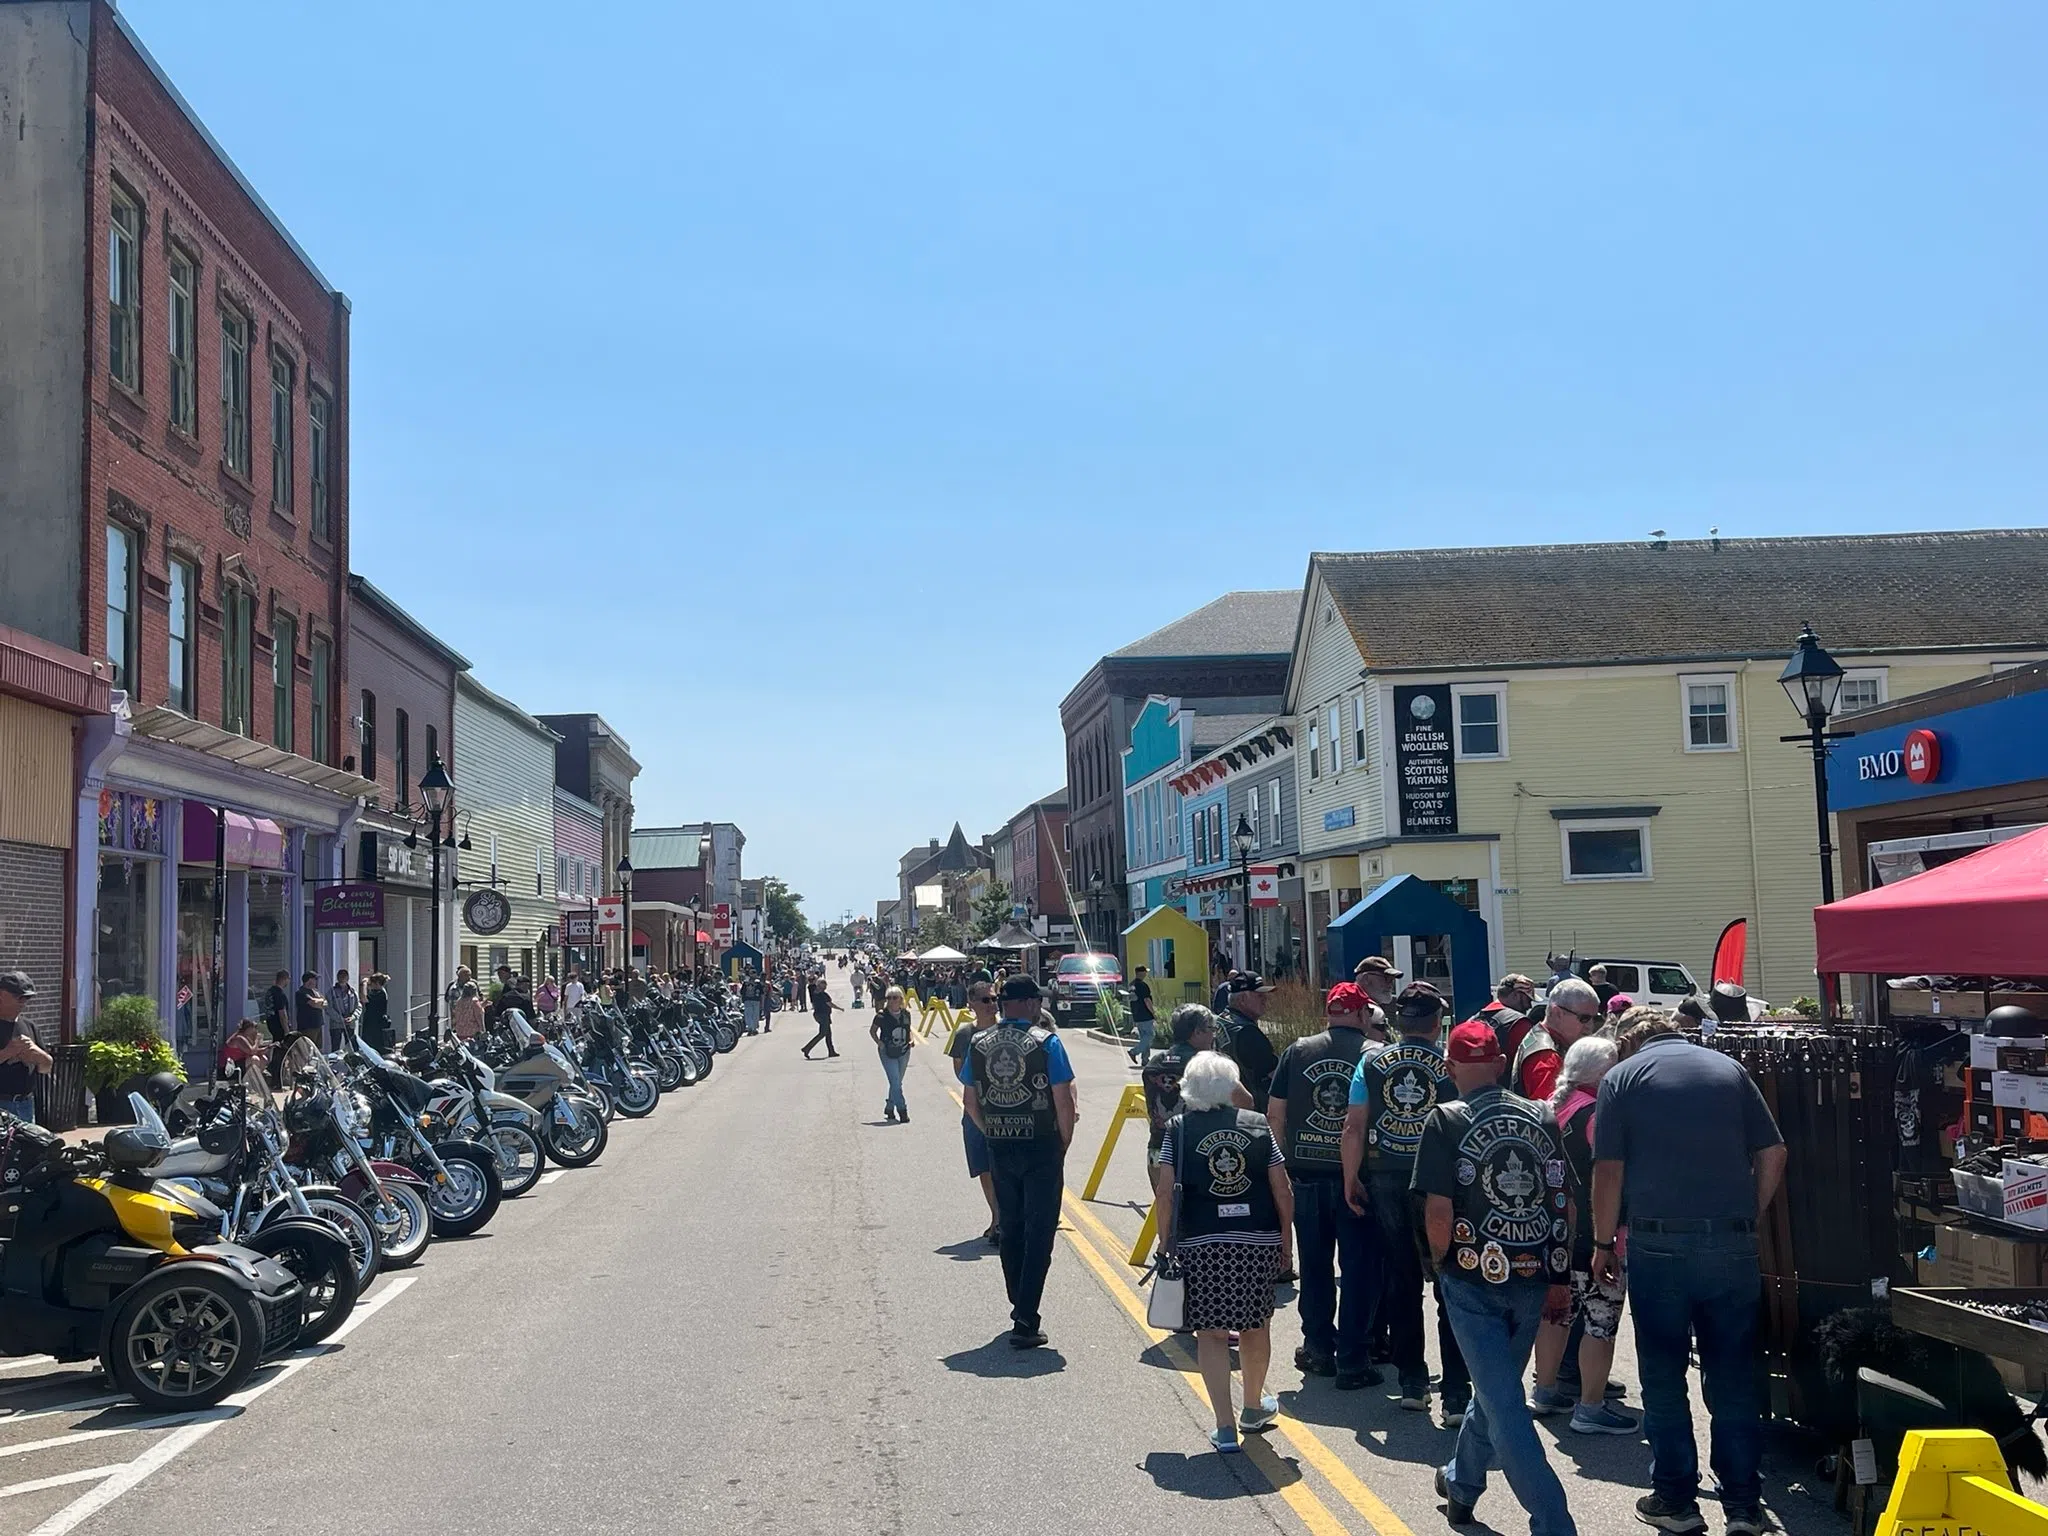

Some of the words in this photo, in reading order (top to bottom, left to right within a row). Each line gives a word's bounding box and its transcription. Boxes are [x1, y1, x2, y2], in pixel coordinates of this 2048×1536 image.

[1405, 732, 1445, 742] ENGLISH
[1401, 742, 1449, 752] WOOLLENS
[1858, 750, 1899, 780] BMO
[1404, 766, 1448, 776] SCOTTISH
[1406, 775, 1448, 785] TARTANS
[1405, 792, 1434, 800] HUDSON
[1436, 791, 1450, 799] BAY
[1412, 800, 1443, 809] COATS
[1406, 816, 1452, 826] BLANKETS
[352, 908, 376, 918] thing
[979, 1029, 1034, 1050] VETERANS
[1375, 1048, 1447, 1078] VETERANS
[1308, 1062, 1354, 1079] VETERA
[987, 1088, 1027, 1104] CANADA
[1003, 1115, 1033, 1125] SCOTIA
[1381, 1115, 1425, 1137] CANAD
[993, 1127, 1021, 1137] NAVY
[1300, 1132, 1324, 1143] NOVA
[1199, 1132, 1248, 1152] VETERANS
[1464, 1119, 1550, 1157] VETERANS
[1212, 1180, 1248, 1194] LADIES
[1486, 1214, 1550, 1242] CANADA
